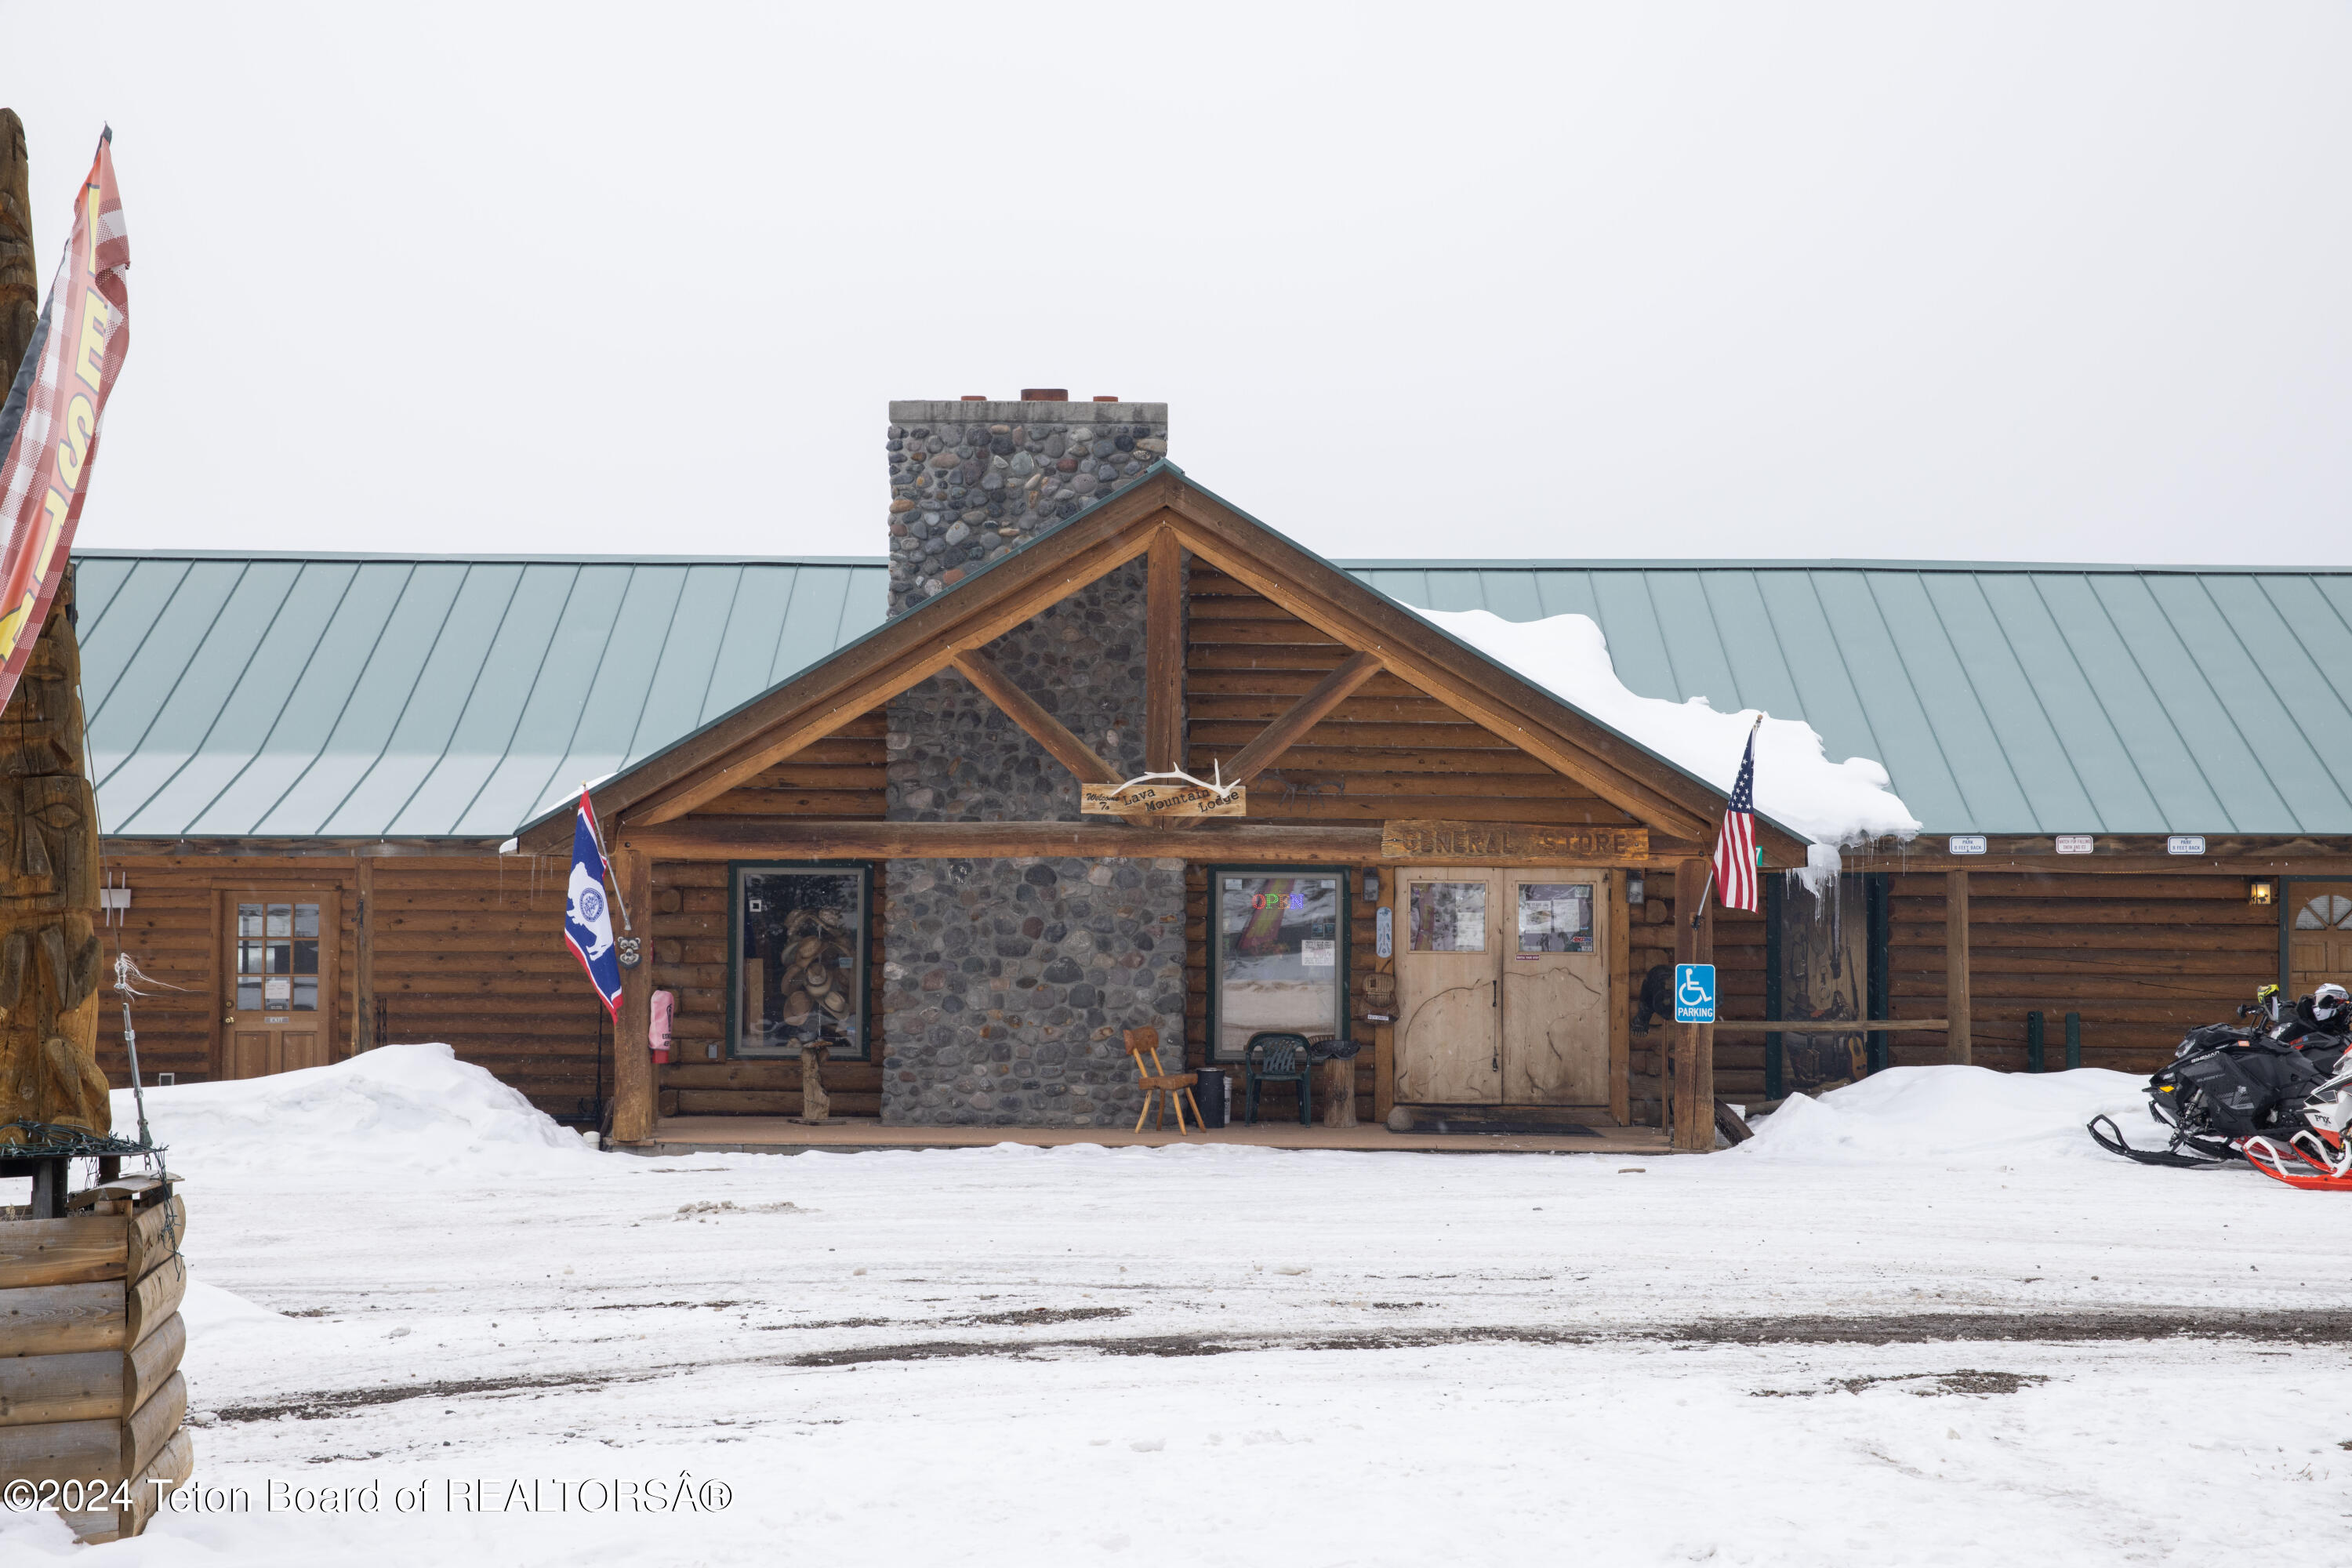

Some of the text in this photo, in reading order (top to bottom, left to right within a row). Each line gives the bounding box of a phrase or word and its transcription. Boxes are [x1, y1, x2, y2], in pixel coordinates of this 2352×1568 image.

[1086, 793, 1120, 802] Welcome
[1123, 788, 1156, 806] Lava
[1145, 788, 1210, 812] Mountain
[1198, 790, 1240, 813] Lodge
[1099, 801, 1110, 811] To
[1401, 830, 1628, 855] GENERAL STORE
[1252, 894, 1305, 909] OPEN
[1678, 1007, 1713, 1017] PARKING
